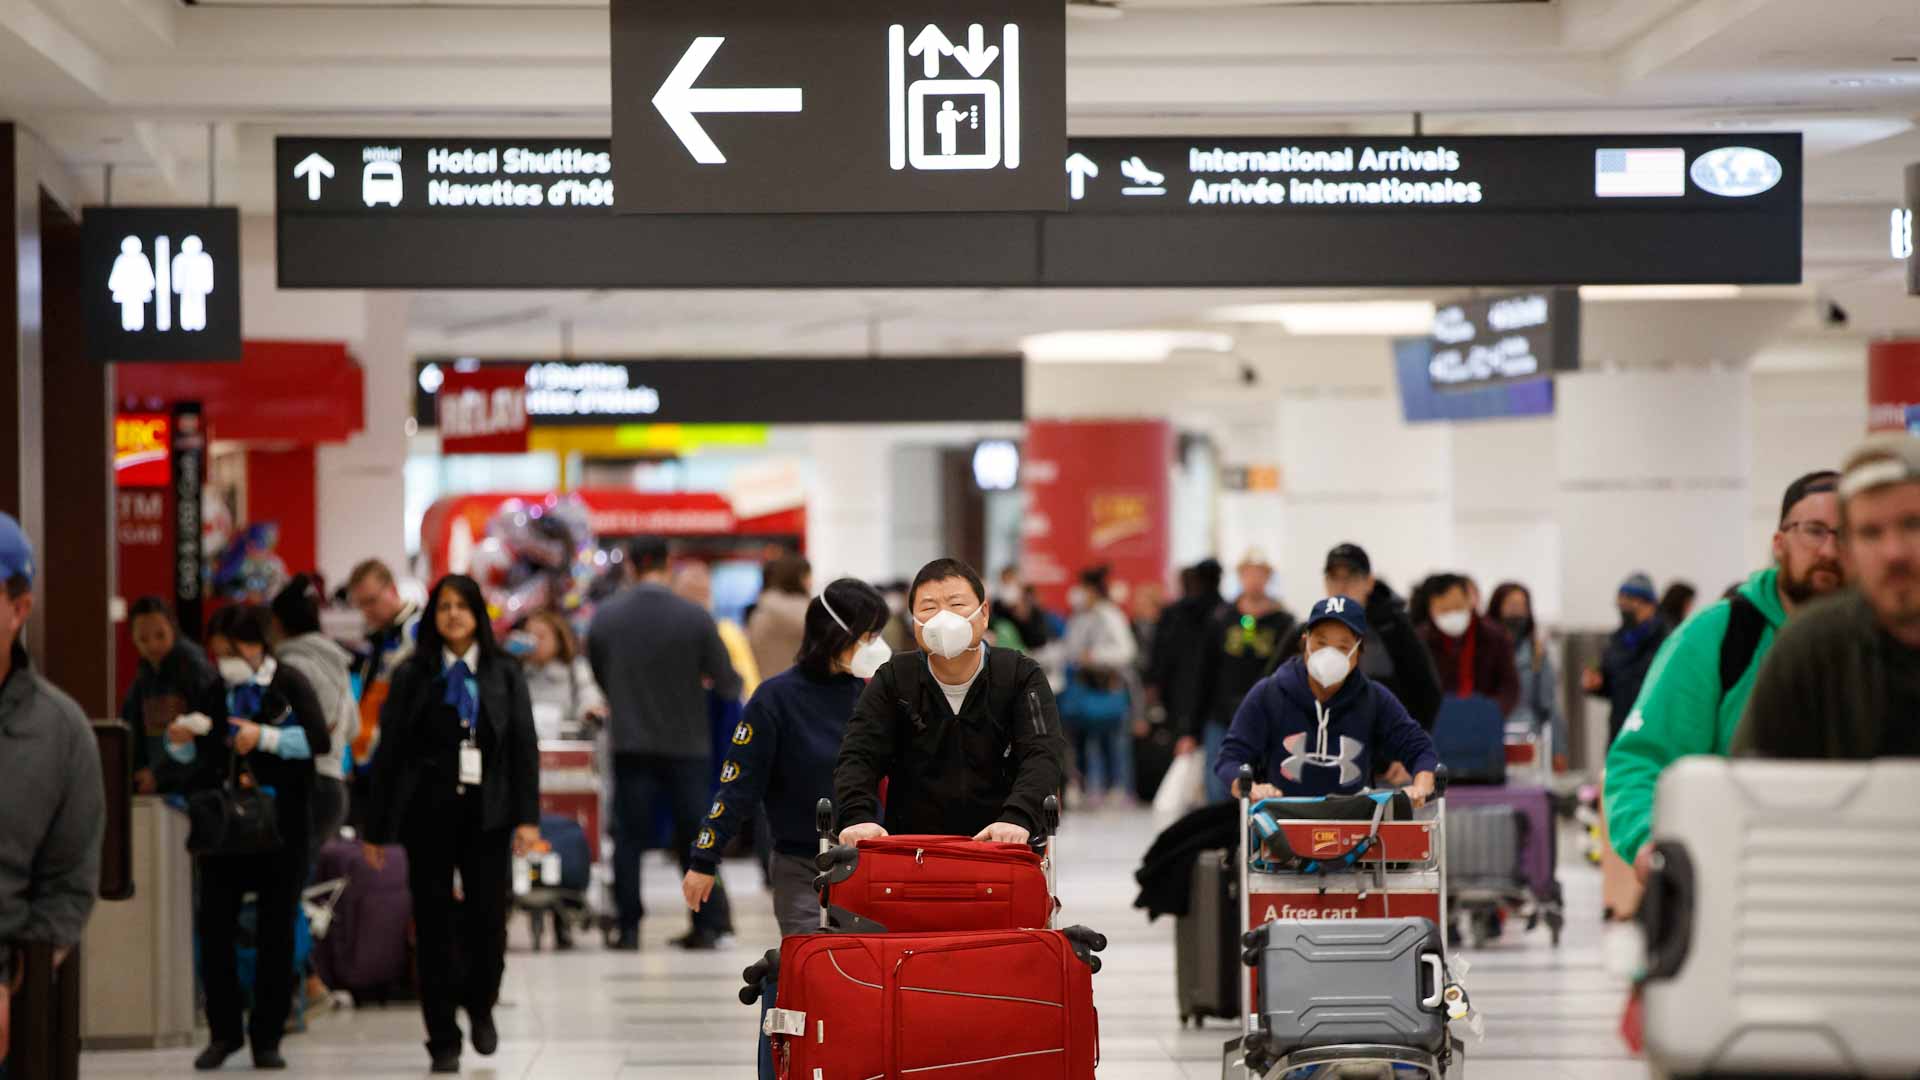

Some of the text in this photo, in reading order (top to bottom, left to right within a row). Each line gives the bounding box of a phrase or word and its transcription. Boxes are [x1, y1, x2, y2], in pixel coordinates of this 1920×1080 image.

[428, 148, 611, 173] Hotel Shuttles
[1190, 146, 1459, 172] International Arrivals
[429, 178, 614, 206] Navettes d'hôt
[1189, 176, 1482, 204] Arrivée Internationales
[1264, 904, 1358, 921] A free cart
